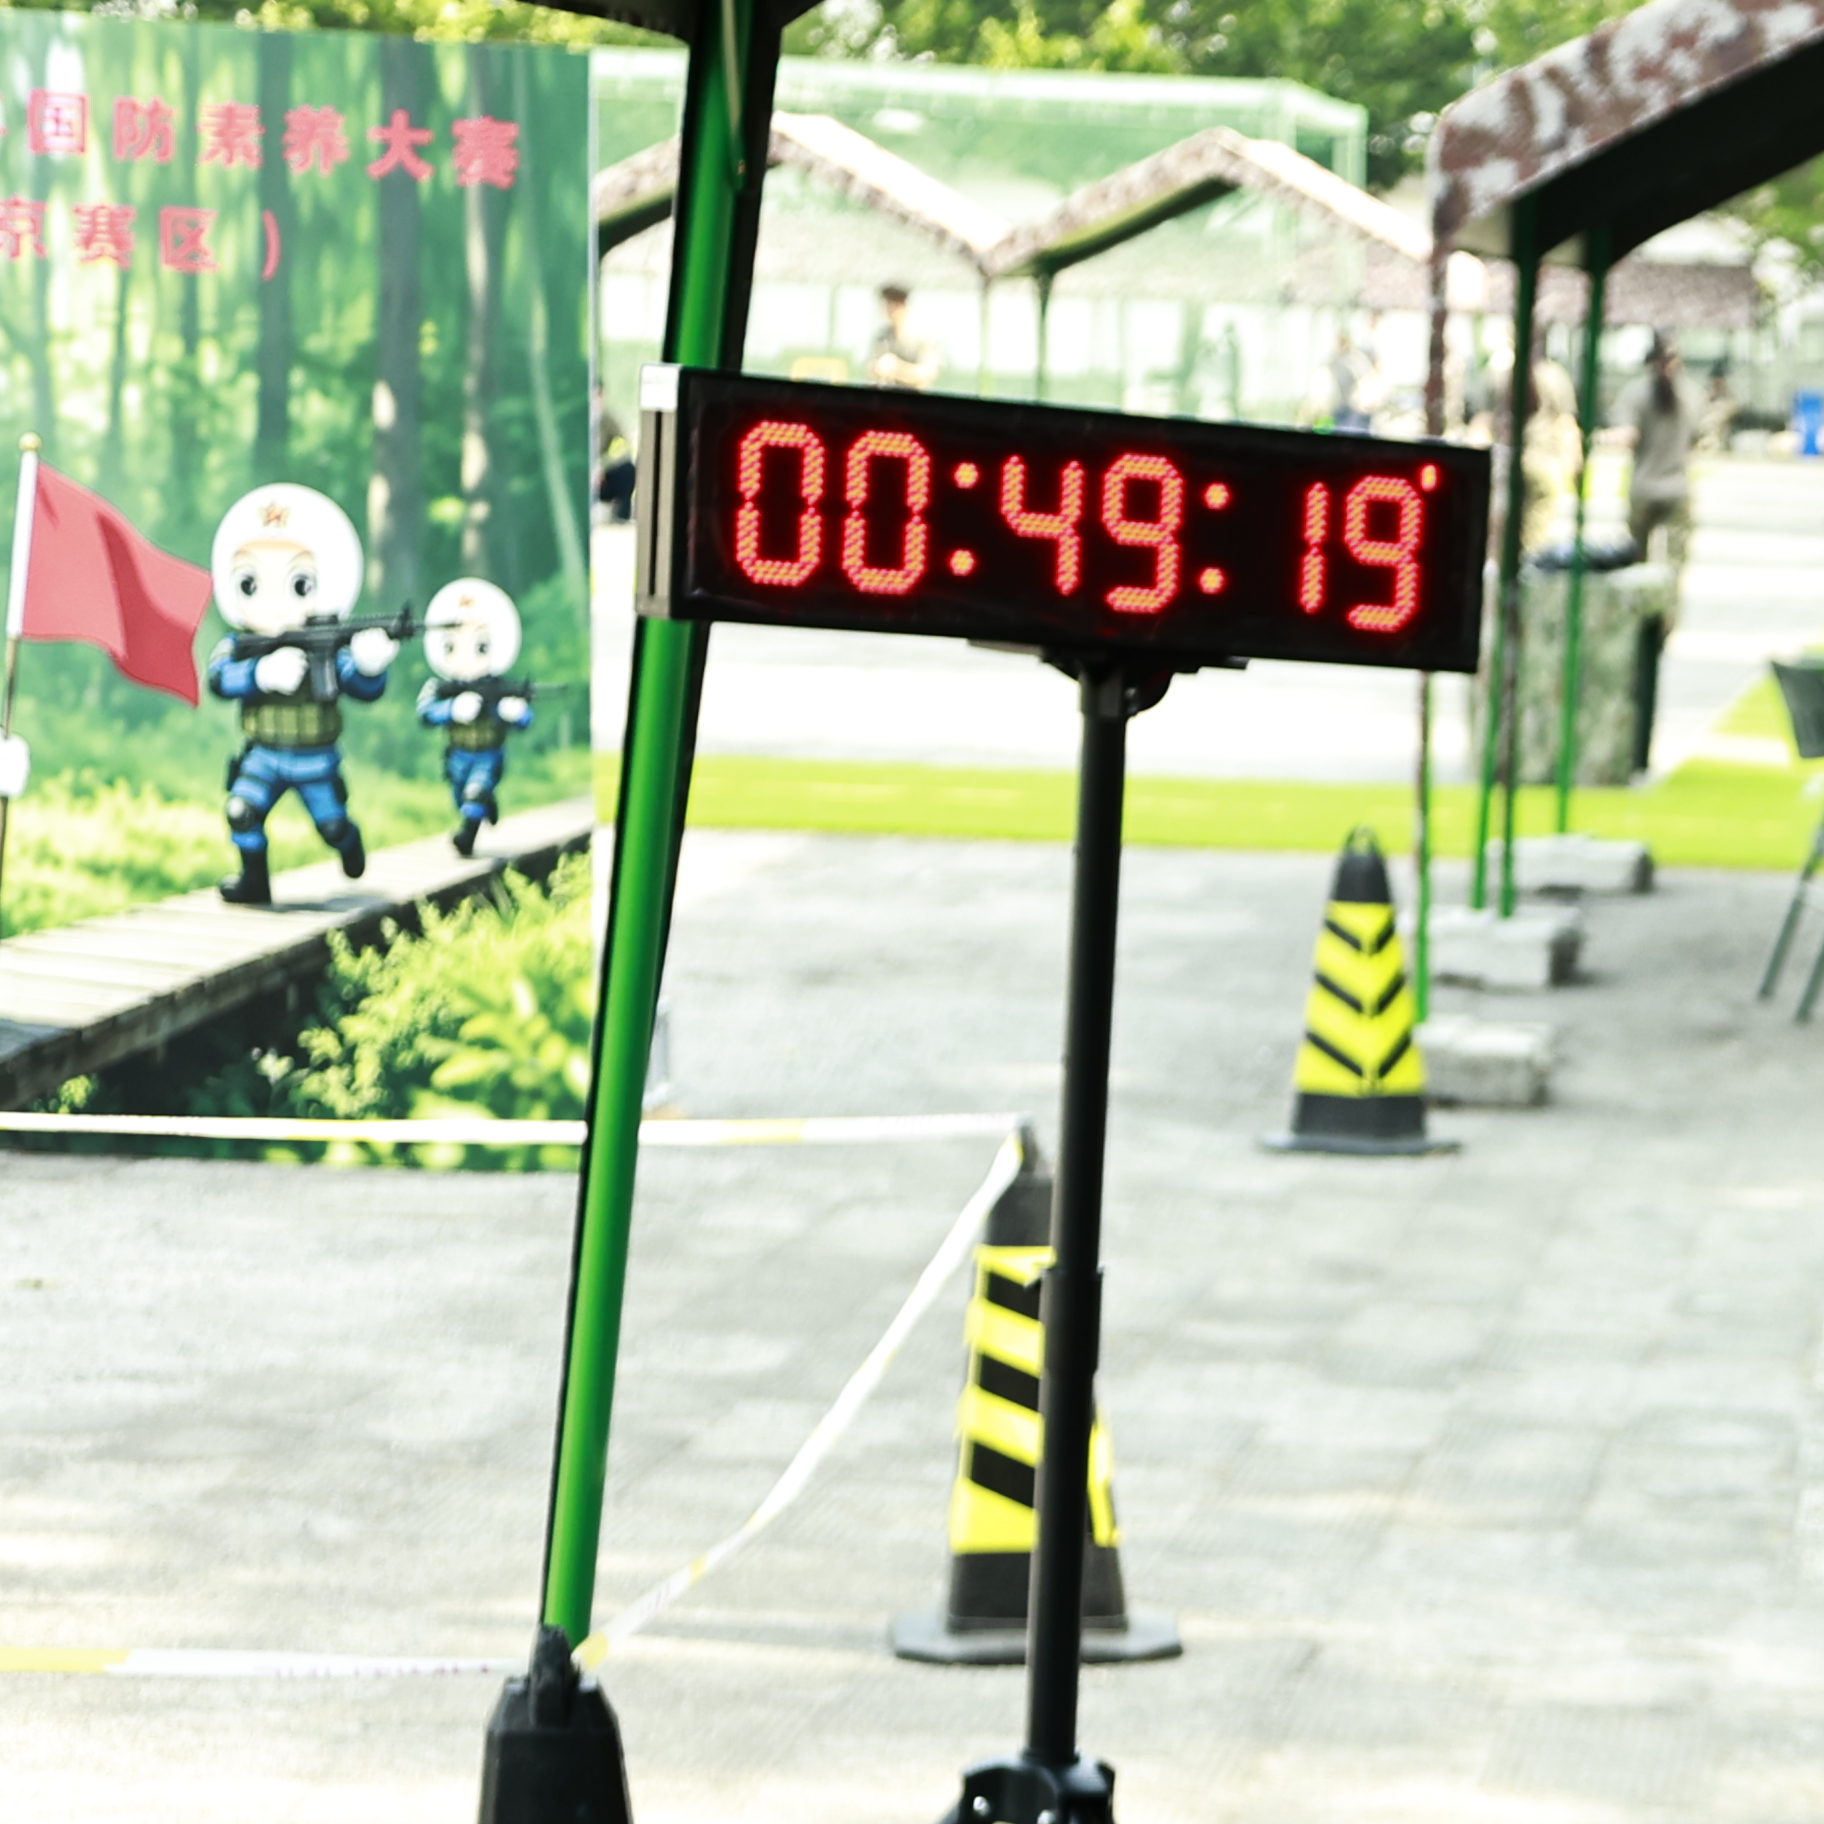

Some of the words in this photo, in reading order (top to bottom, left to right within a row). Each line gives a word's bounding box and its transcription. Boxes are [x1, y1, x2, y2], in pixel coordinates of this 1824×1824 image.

[0, 86, 520, 191] 国防素养大赛
[735, 419, 1425, 634] 00:49:19
